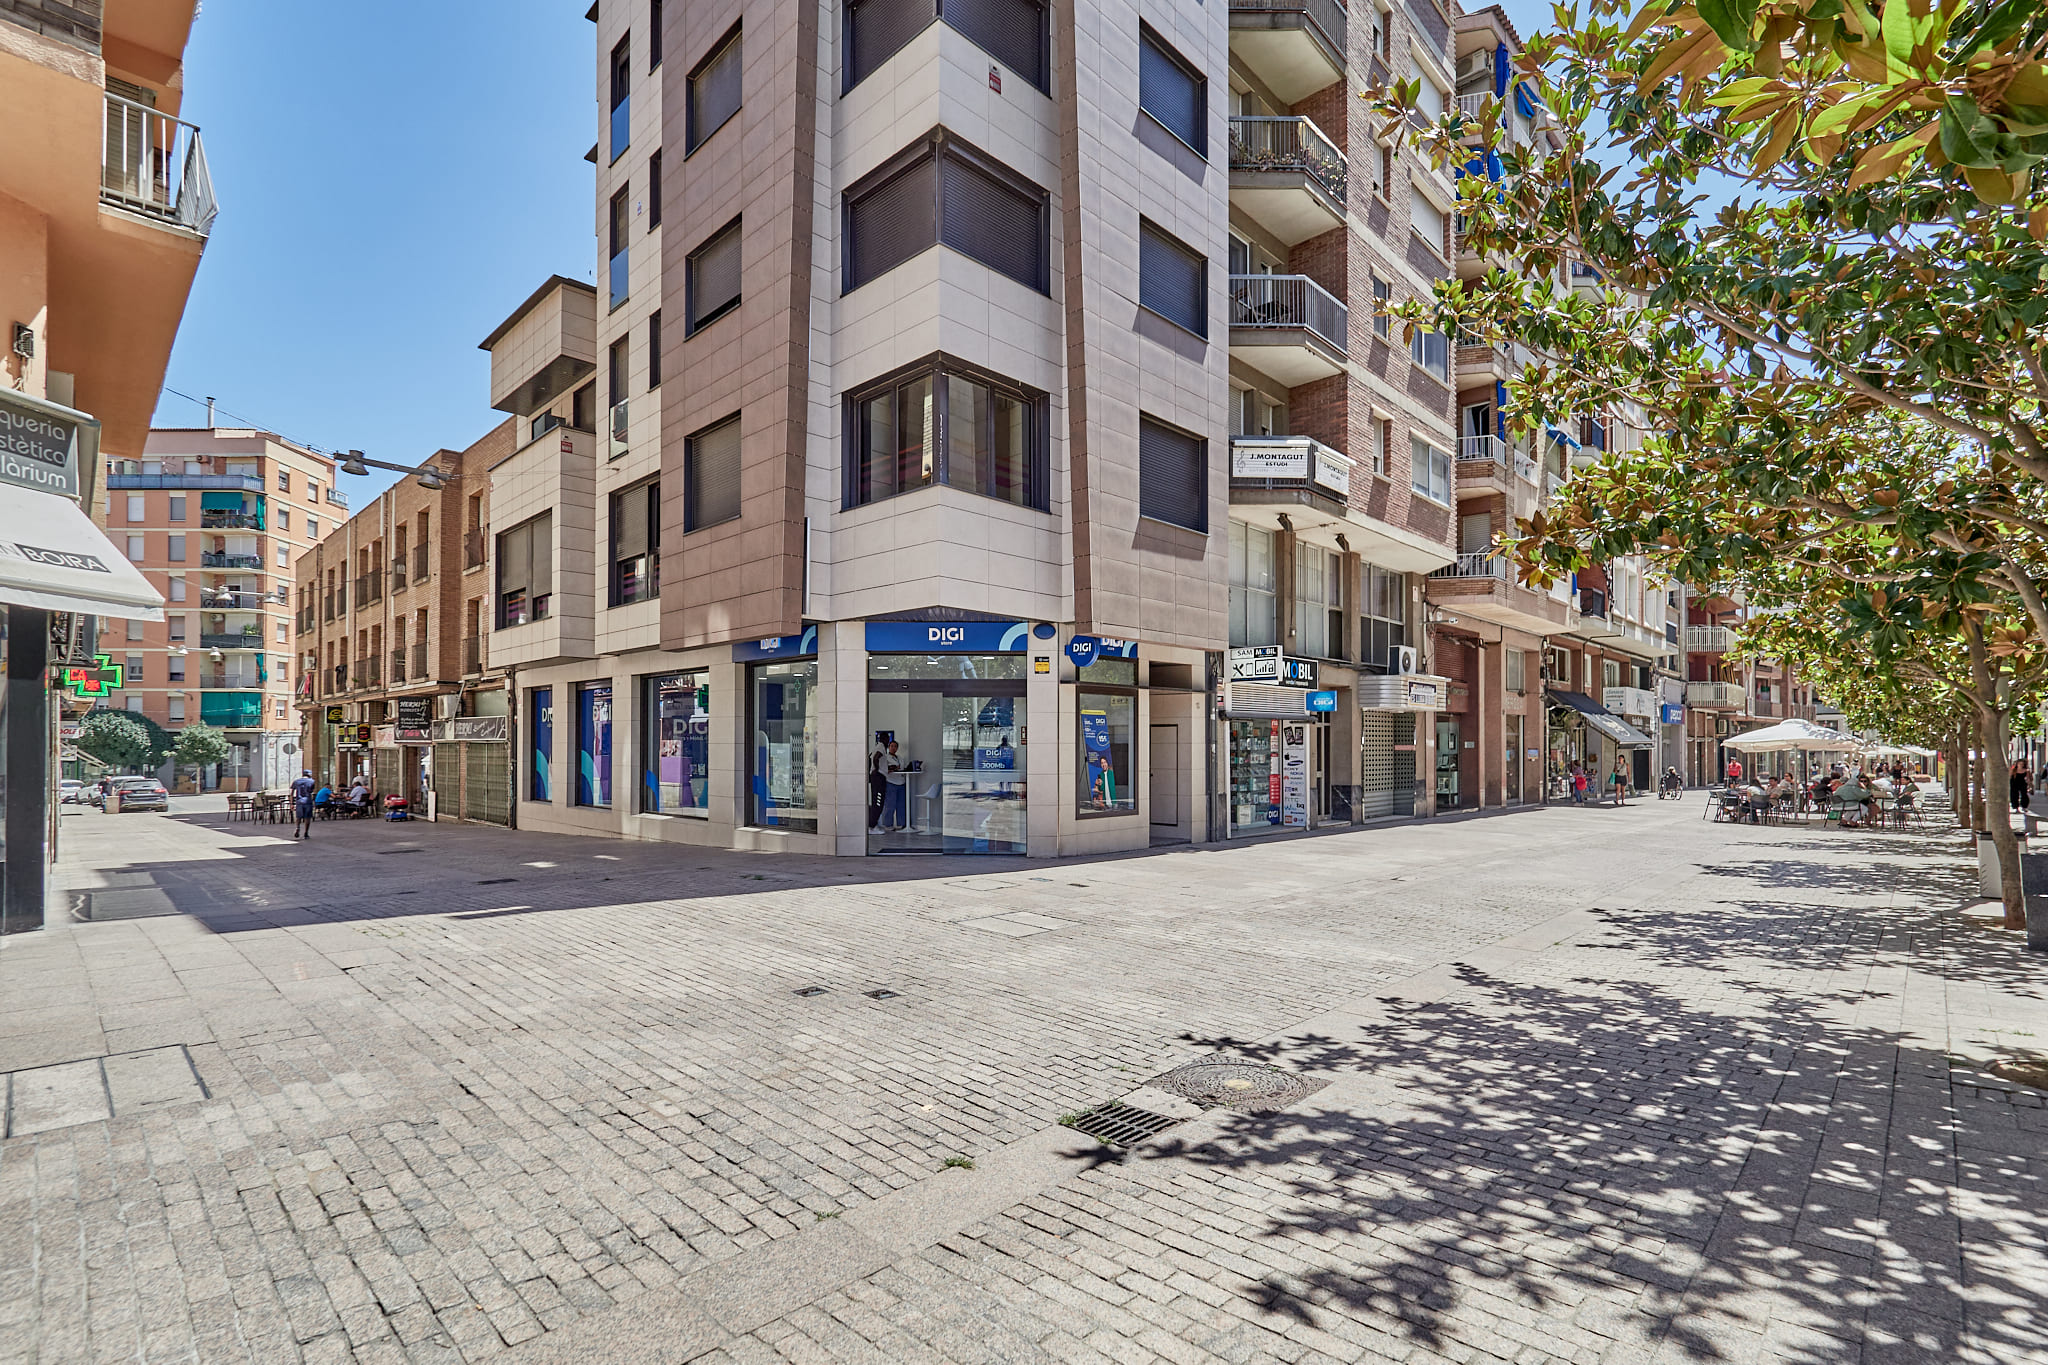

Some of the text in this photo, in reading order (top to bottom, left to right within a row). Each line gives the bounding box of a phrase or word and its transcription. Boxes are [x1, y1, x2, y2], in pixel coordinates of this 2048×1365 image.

[22, 547, 107, 571] BOIRA
[928, 627, 964, 641] DIGI
[1072, 642, 1092, 653] DIGI
[1268, 810, 1279, 818] DIGI
